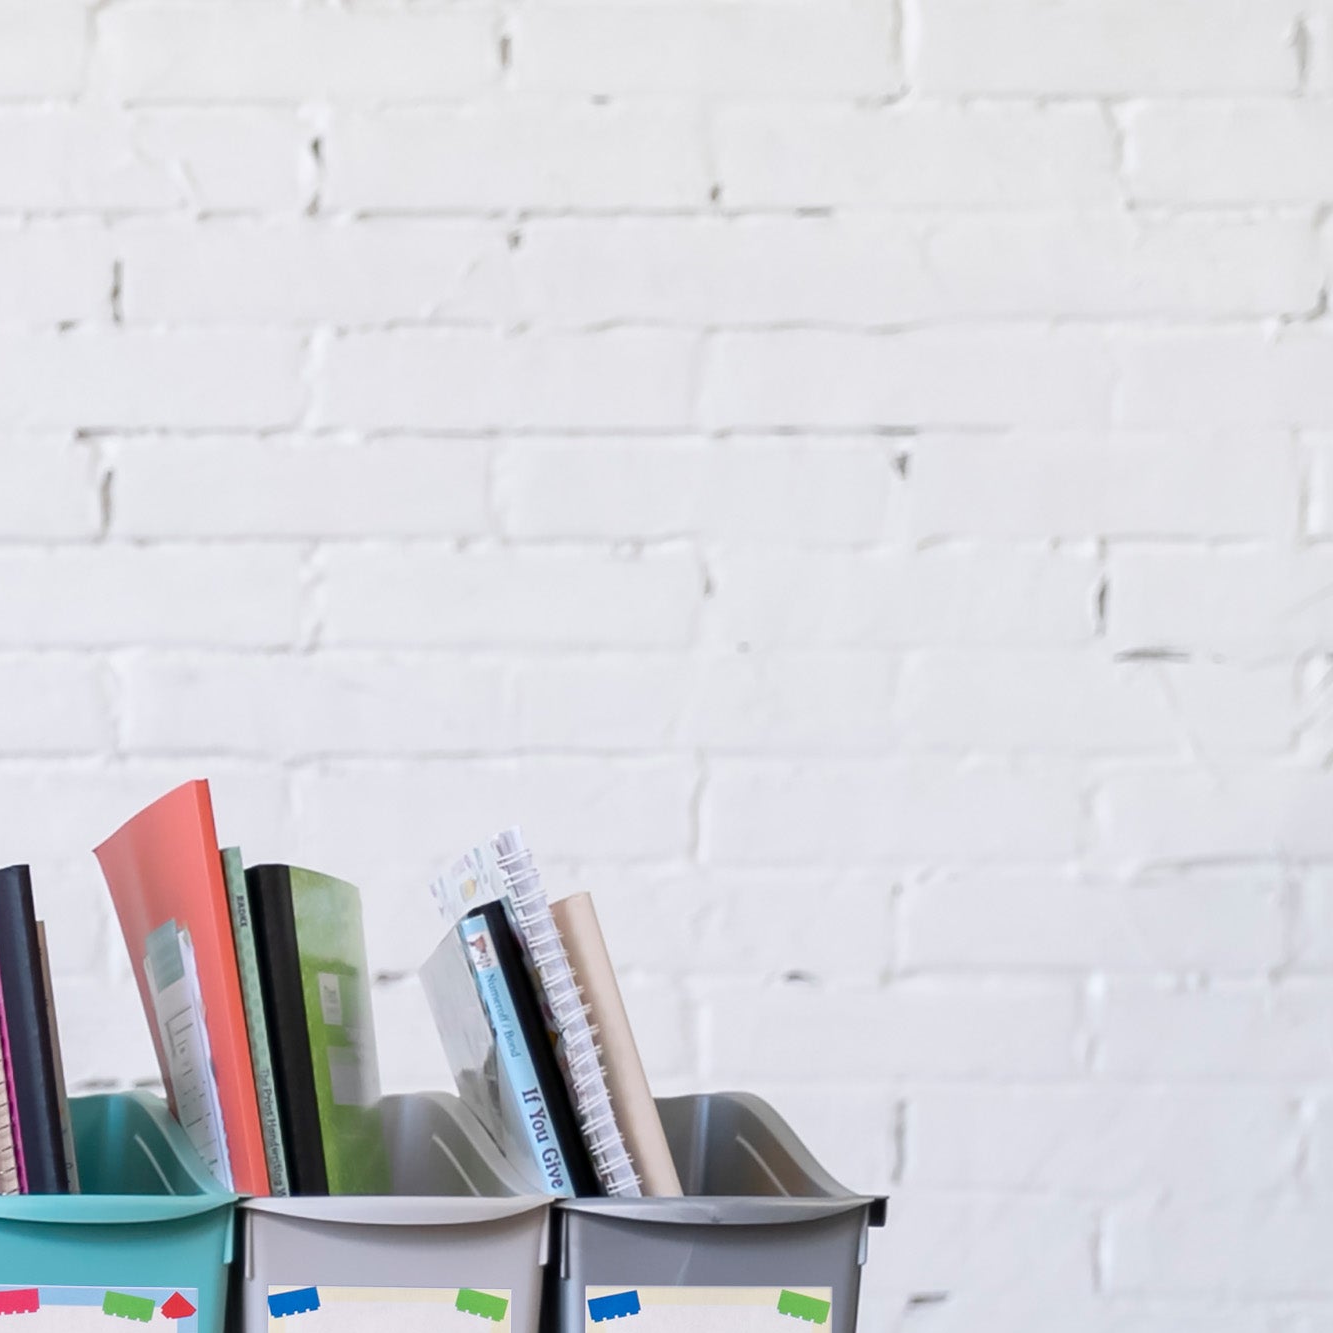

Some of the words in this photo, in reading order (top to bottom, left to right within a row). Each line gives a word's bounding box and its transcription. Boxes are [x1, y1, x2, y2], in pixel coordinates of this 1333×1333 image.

[521, 1087, 542, 1104] If
[529, 1107, 549, 1144] You
[541, 1148, 564, 1189] Give
